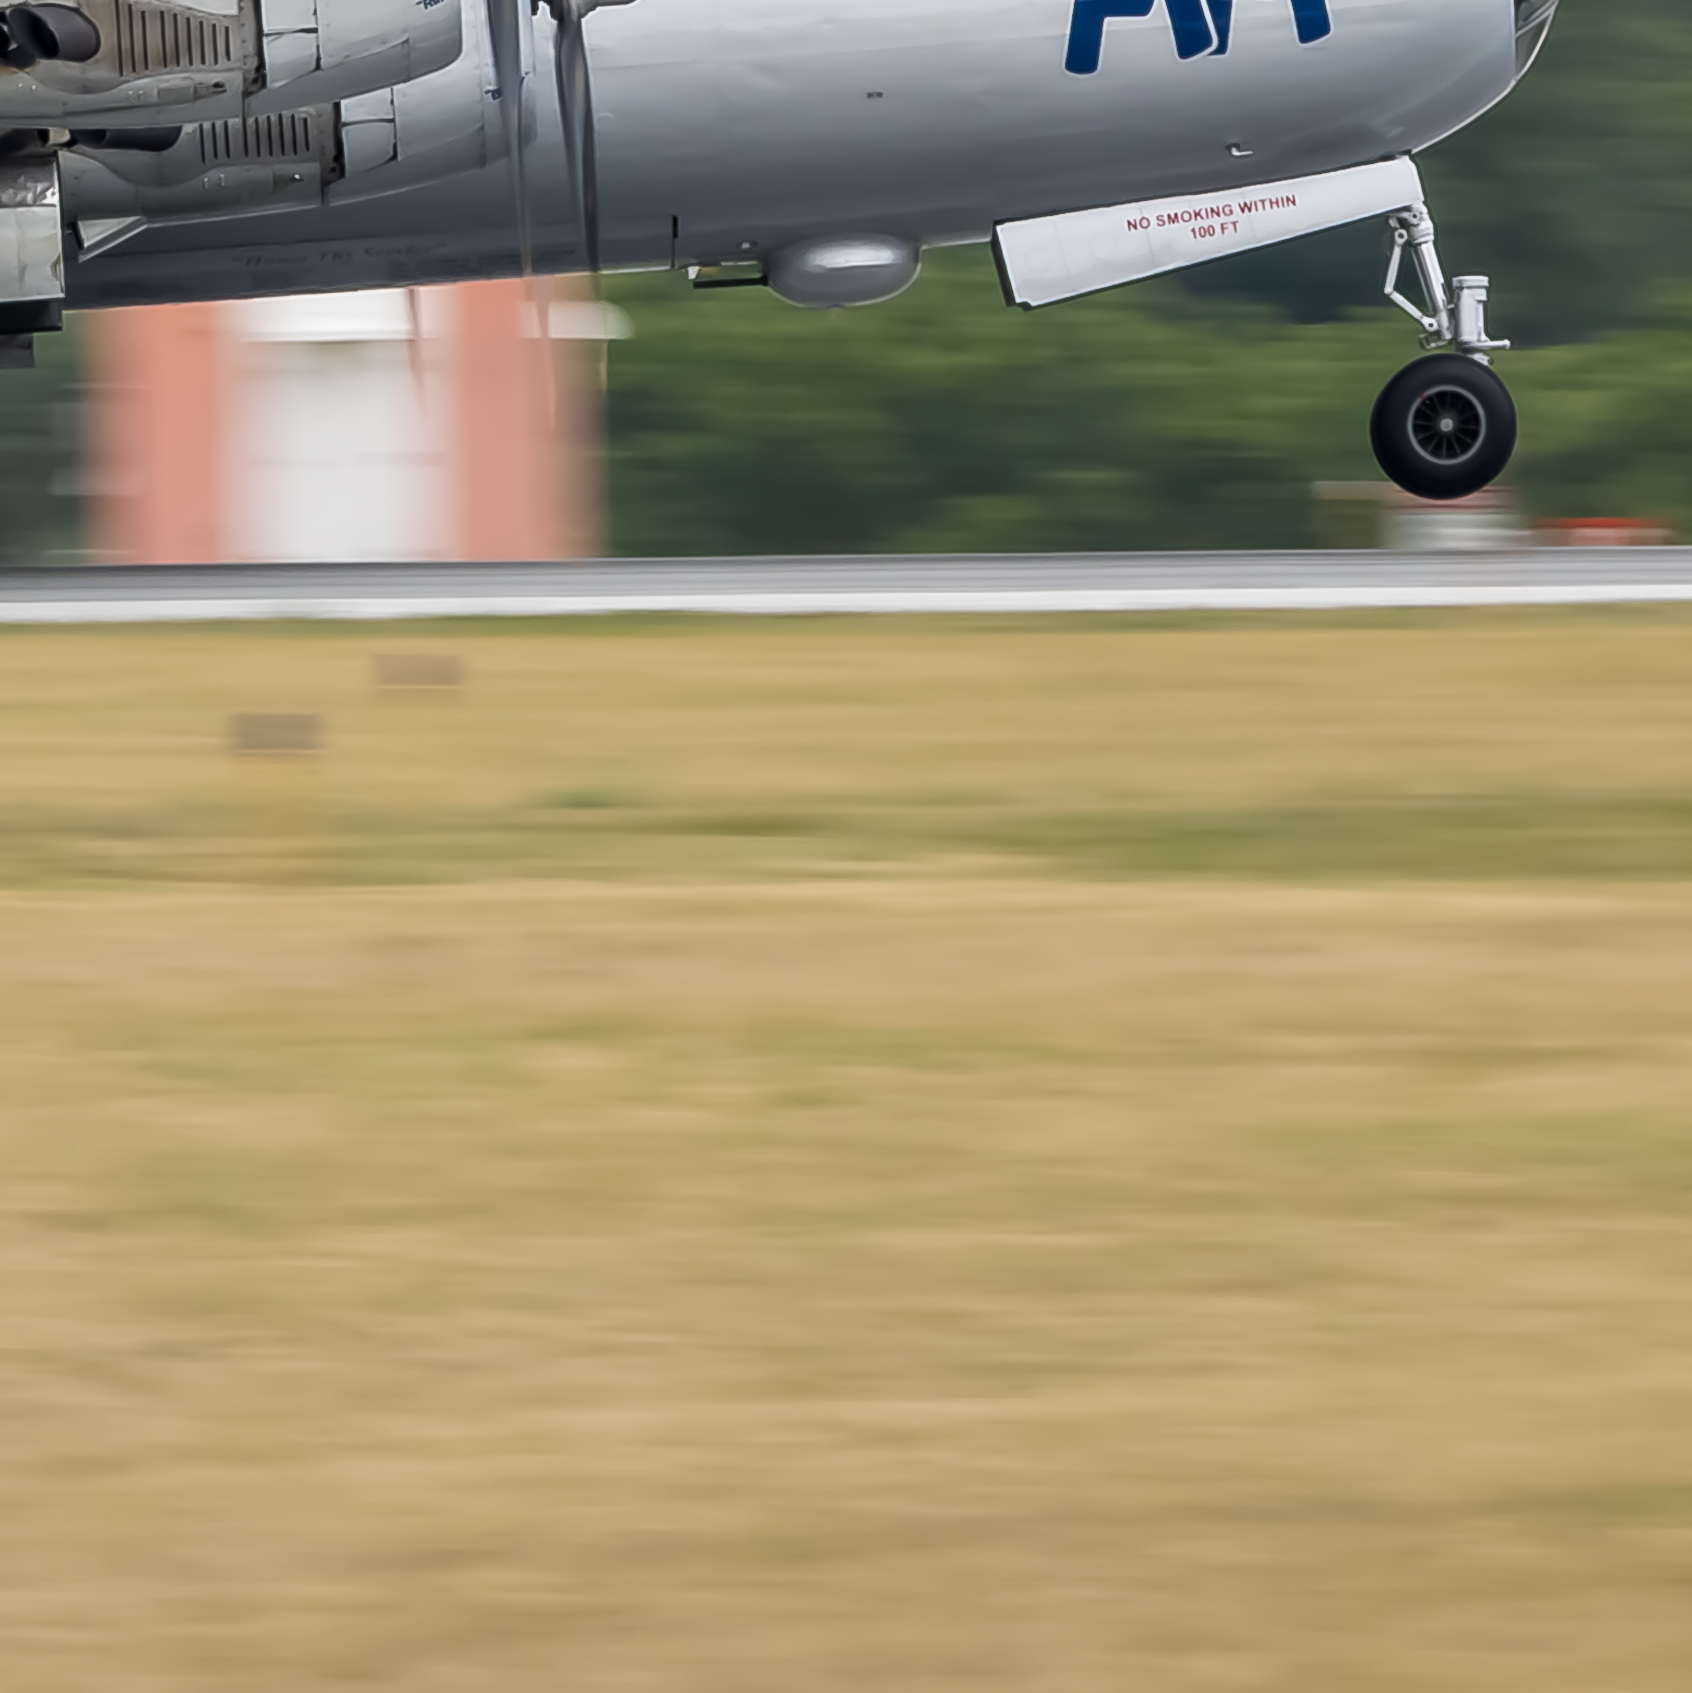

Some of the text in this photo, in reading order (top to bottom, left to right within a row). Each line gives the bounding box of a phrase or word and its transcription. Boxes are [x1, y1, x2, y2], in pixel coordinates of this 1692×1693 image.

[1126, 194, 1298, 232] NO SMOKING WITHIN
[1190, 220, 1240, 240] 100 FT
